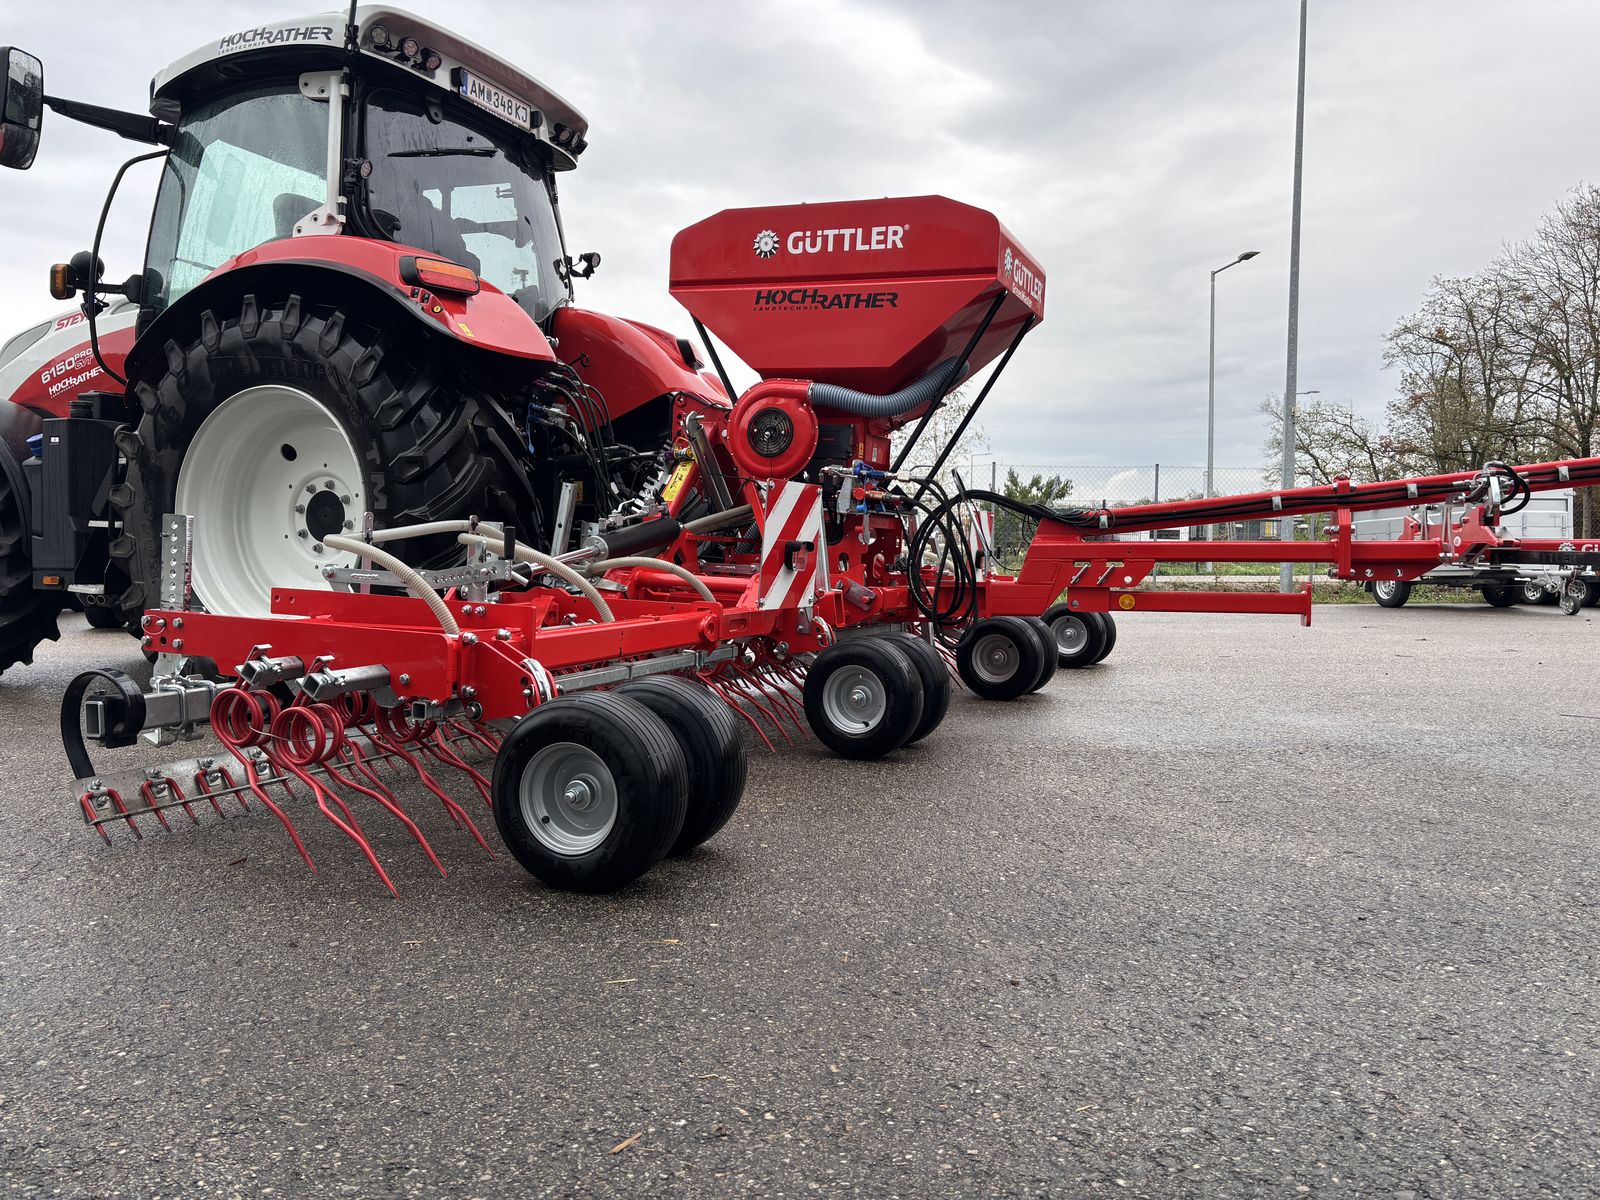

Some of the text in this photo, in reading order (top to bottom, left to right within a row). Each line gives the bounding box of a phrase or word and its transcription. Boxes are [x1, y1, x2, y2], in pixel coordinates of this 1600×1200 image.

[219, 27, 333, 49] HOCHRATHER
[469, 79, 486, 102] AM
[493, 91, 513, 116] 348
[514, 101, 528, 123] KJ
[754, 288, 899, 310] HOCHRATHER
[41, 357, 76, 384] 6150
